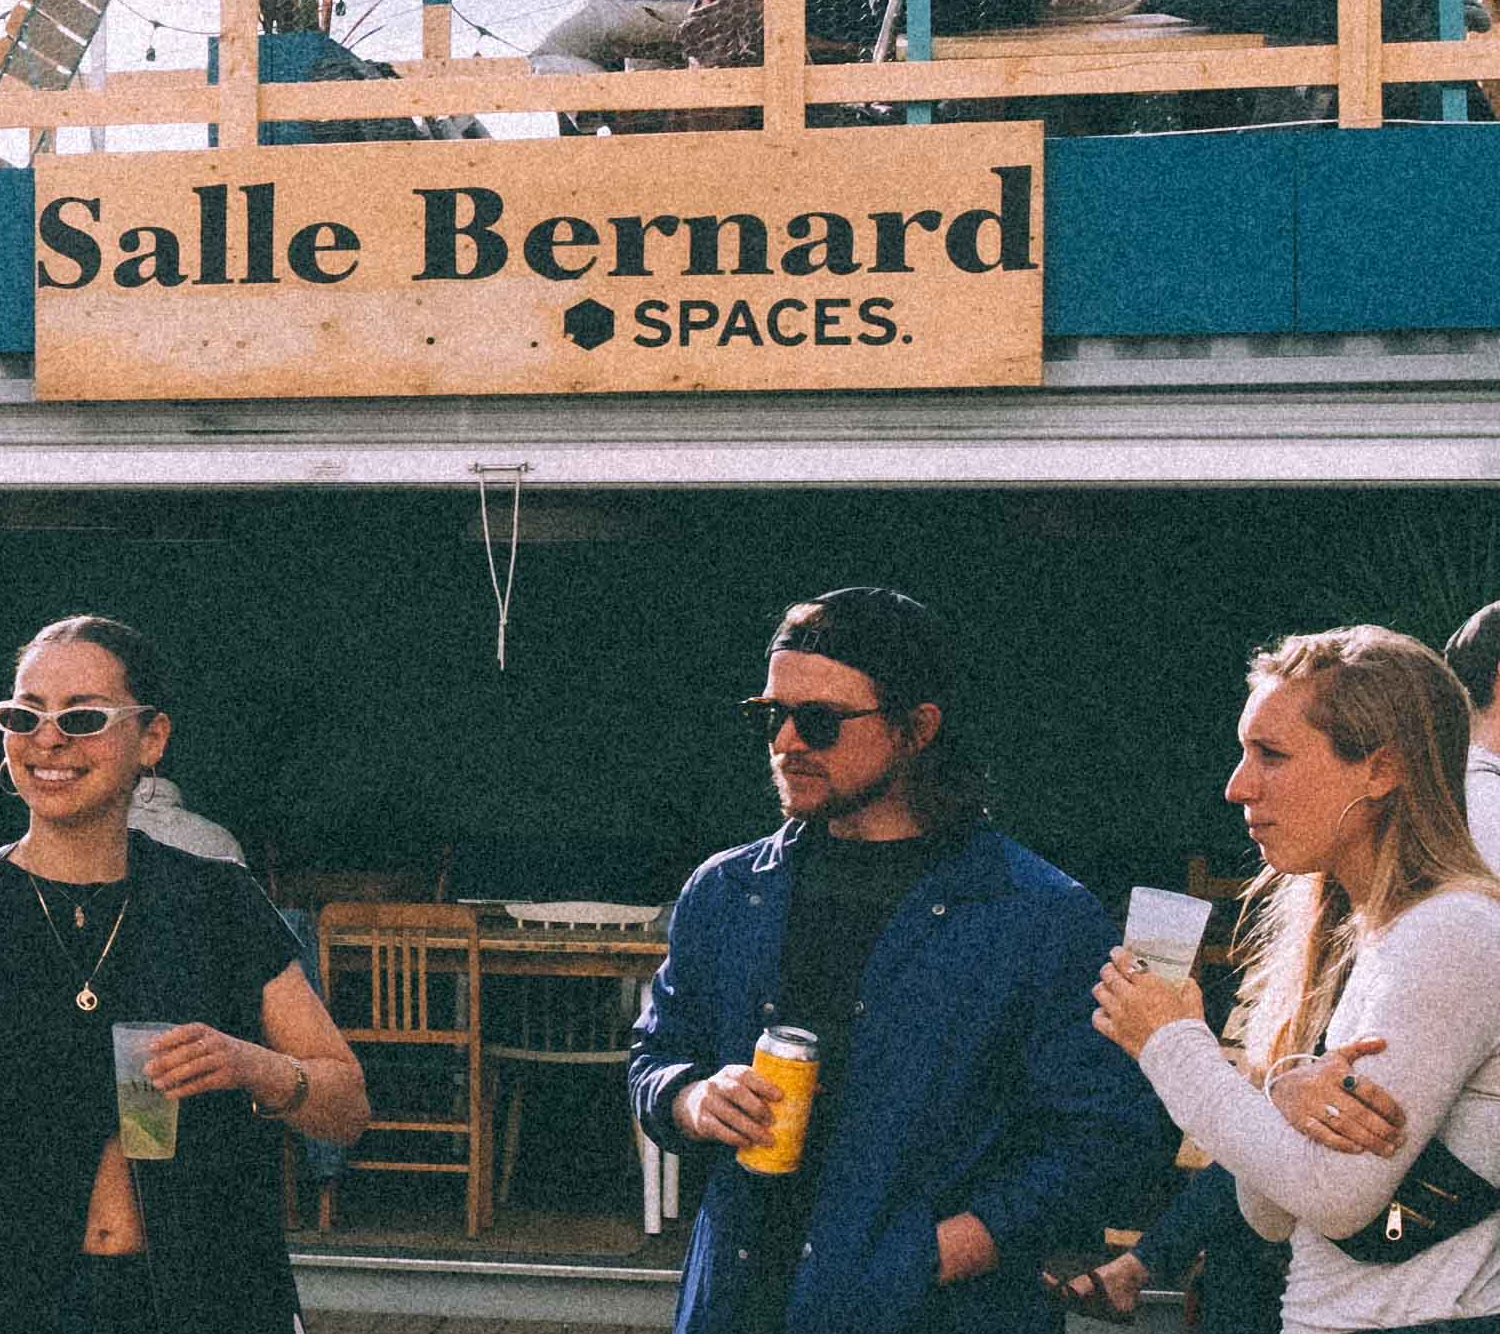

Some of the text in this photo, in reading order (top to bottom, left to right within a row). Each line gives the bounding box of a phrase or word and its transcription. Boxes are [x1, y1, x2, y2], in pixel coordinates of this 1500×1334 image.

[37, 165, 1038, 289] Salle Bernard
[632, 297, 914, 349] SPACES.
